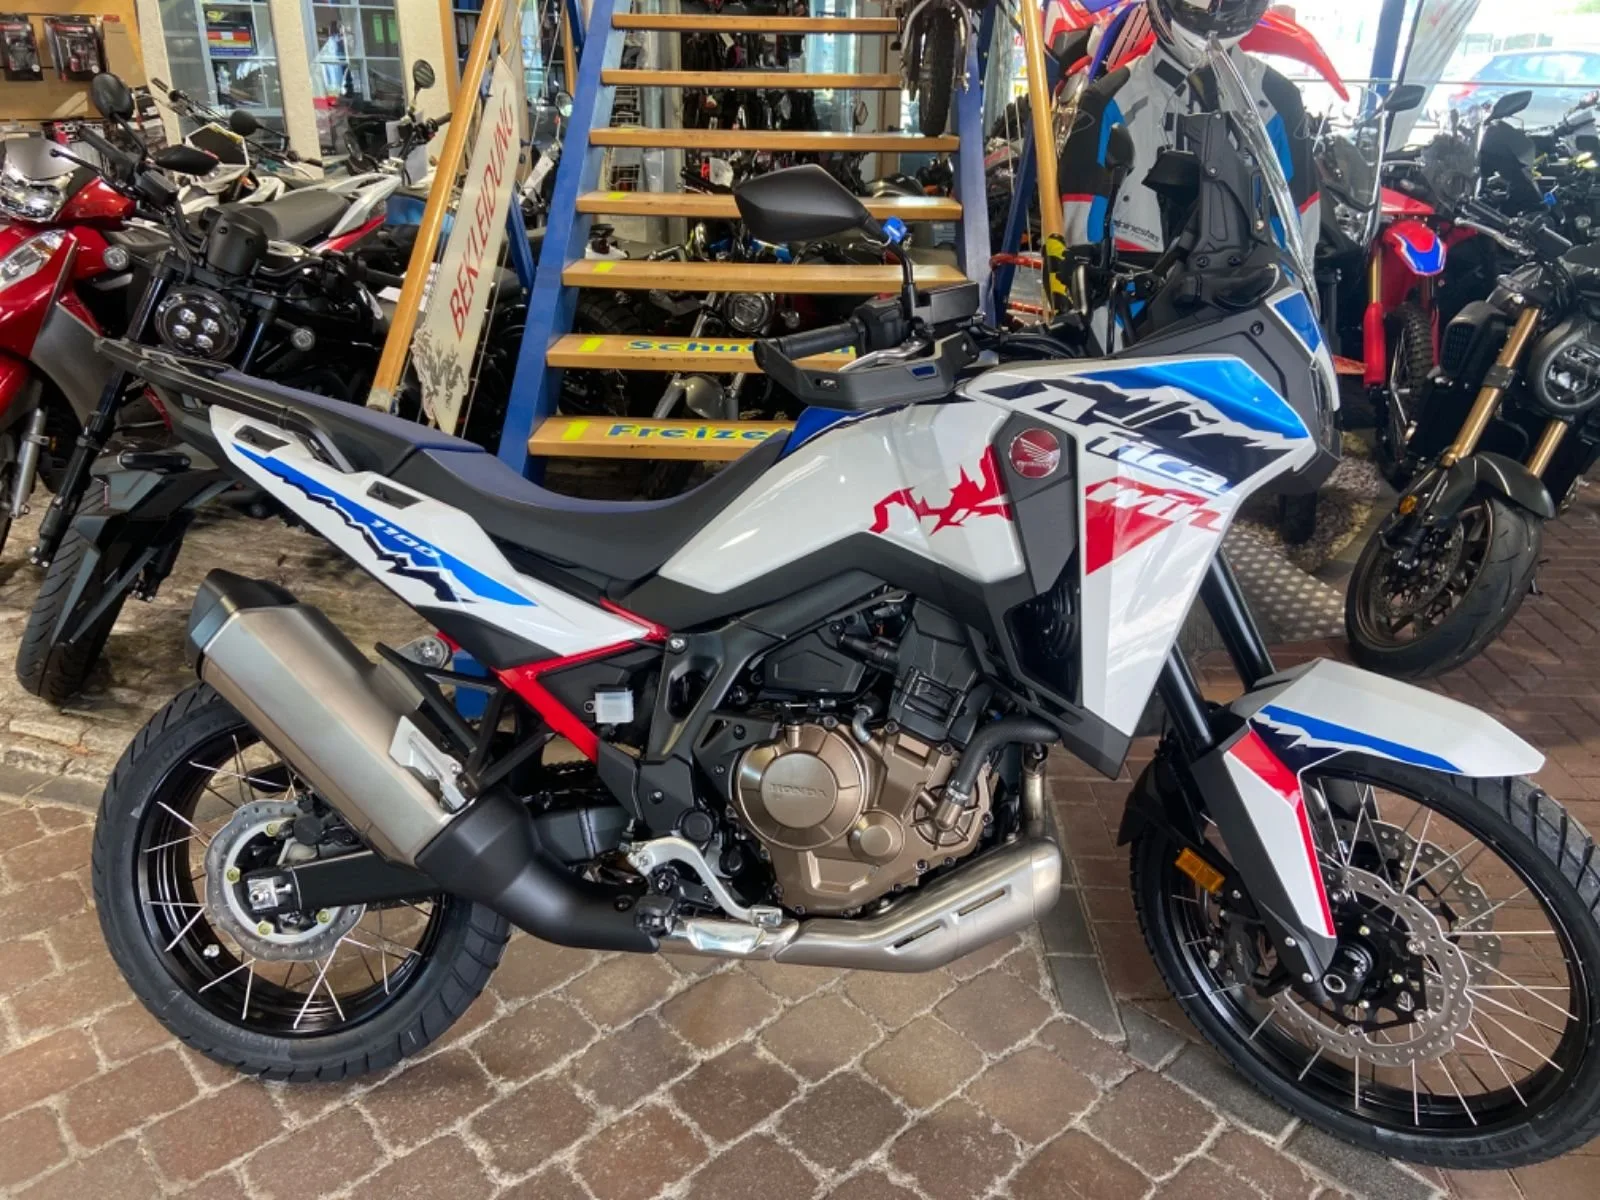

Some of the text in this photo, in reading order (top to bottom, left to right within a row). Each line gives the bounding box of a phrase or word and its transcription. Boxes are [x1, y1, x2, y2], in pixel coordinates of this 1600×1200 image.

[449, 87, 514, 341] BEKLEIDUNG
[627, 338, 754, 354] Schu
[607, 424, 770, 440] Freize
[370, 518, 441, 559] 1100
[769, 783, 828, 799] HONDA
